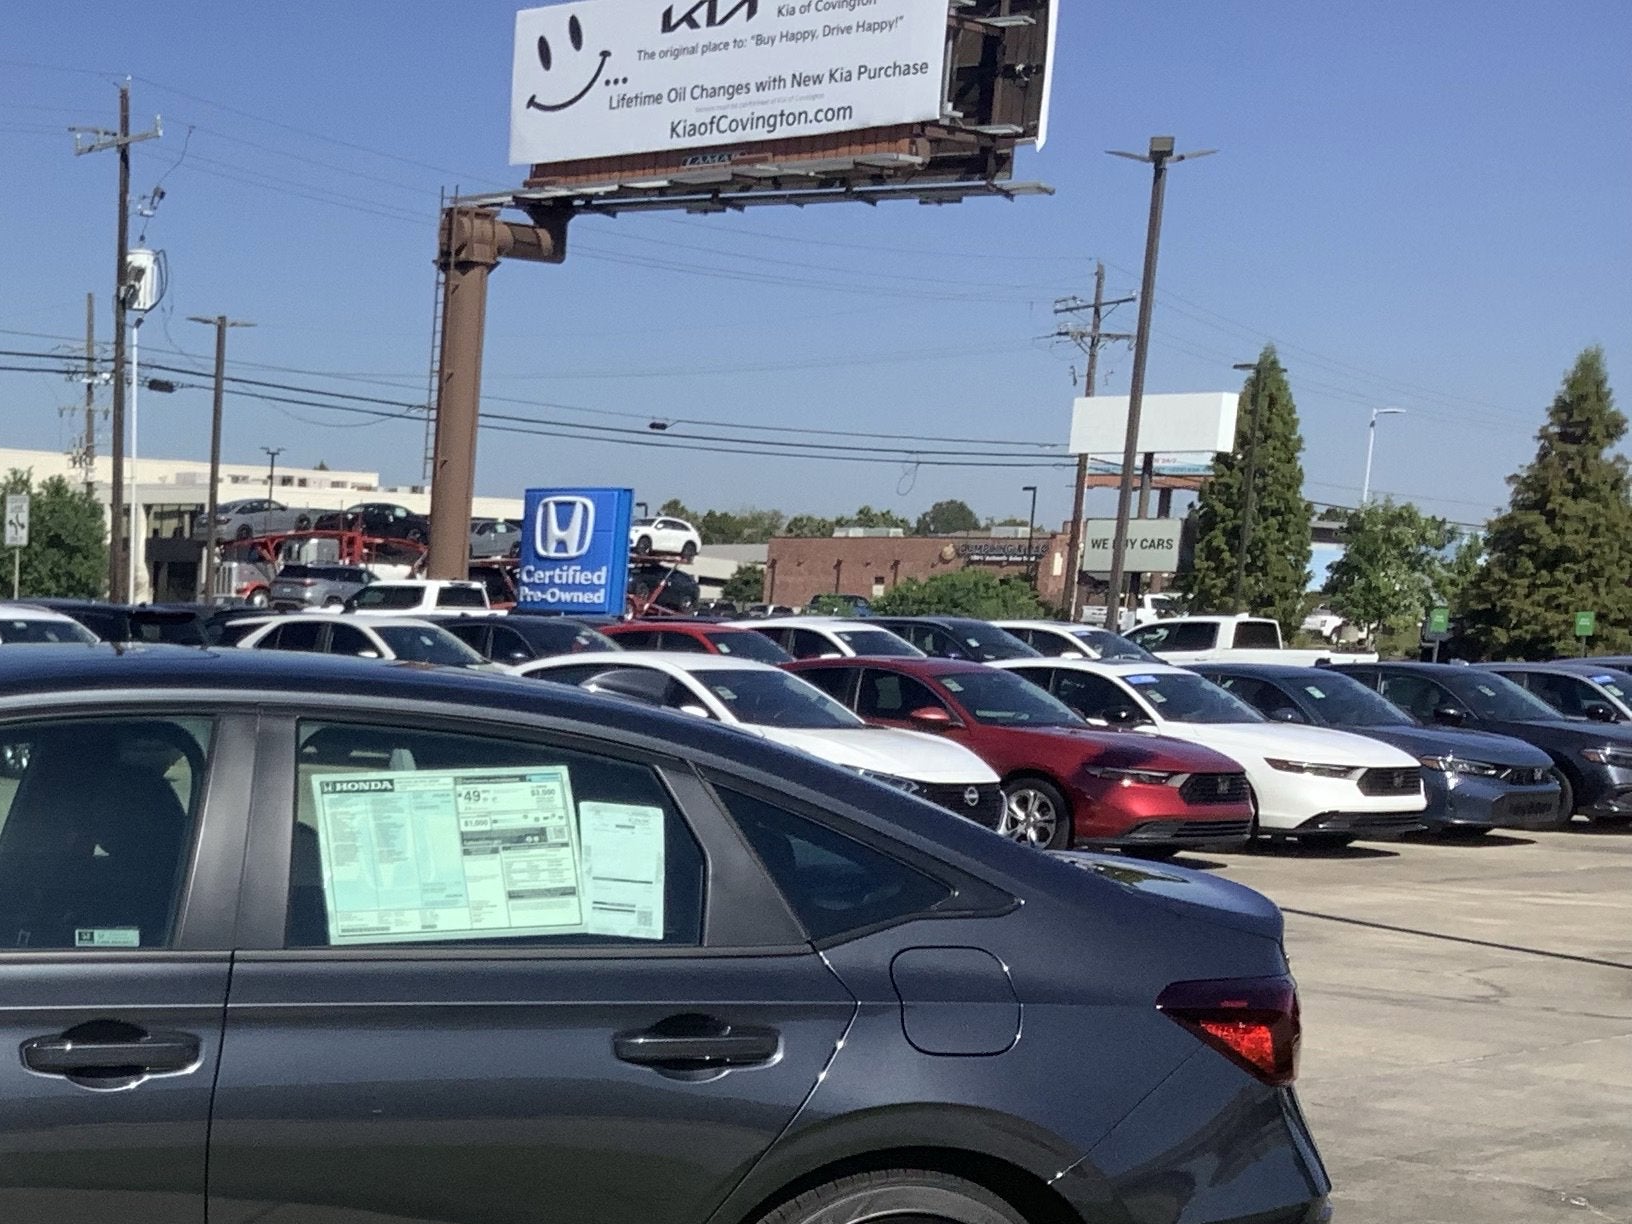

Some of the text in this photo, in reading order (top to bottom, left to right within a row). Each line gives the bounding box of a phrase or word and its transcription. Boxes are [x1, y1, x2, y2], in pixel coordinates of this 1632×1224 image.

[777, 3, 796, 18] Kia
[799, 2, 812, 15] of
[637, 49, 656, 61] The
[658, 43, 699, 61] original
[701, 40, 730, 57] place
[733, 38, 748, 49] to:
[779, 29, 818, 44] Happy,
[822, 23, 853, 38] Drive
[609, 93, 664, 110] Lifetime
[667, 87, 687, 104] Oil
[690, 81, 751, 102] Changes
[755, 75, 787, 93] with
[791, 72, 825, 89] New
[829, 68, 853, 84] Kia
[857, 61, 929, 81] Purchase
[670, 105, 853, 139] KiaofCovington.com
[1091, 538, 1109, 550] WE
[1140, 538, 1174, 550] CARS
[521, 565, 607, 585] Certified
[519, 587, 606, 604] Pre-Owned
[335, 780, 393, 792] HONDA
[464, 790, 481, 801] 49
